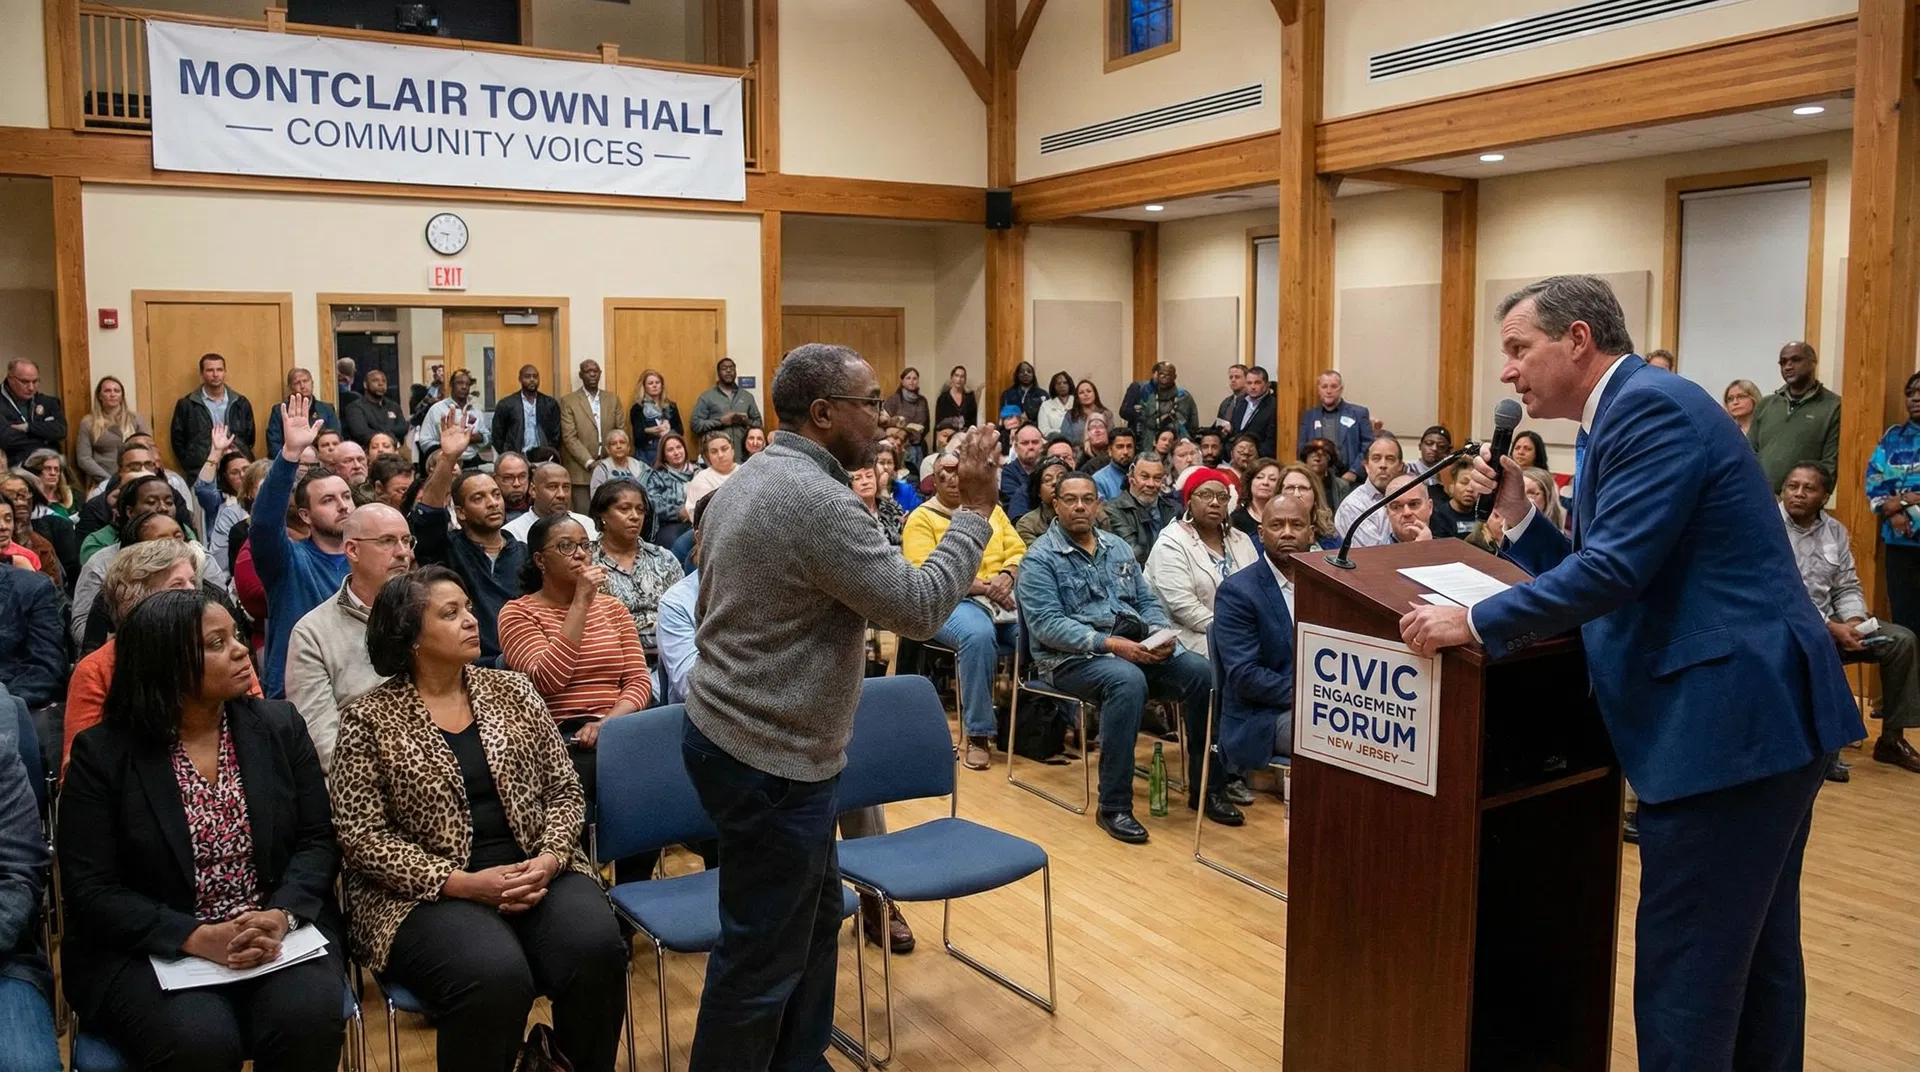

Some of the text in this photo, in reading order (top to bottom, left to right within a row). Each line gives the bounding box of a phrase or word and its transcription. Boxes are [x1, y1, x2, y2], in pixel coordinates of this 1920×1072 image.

[179, 58, 724, 136] MONTCLAIR TOWN HALL
[287, 117, 644, 167] COMMUNITY VOICES
[435, 266, 462, 287] EXIT
[1314, 648, 1418, 701] CIVIC
[1312, 701, 1416, 752] FORUM
[1313, 684, 1417, 721] ENGAGEMENT
[1327, 735, 1399, 764] NEW JERSEY
